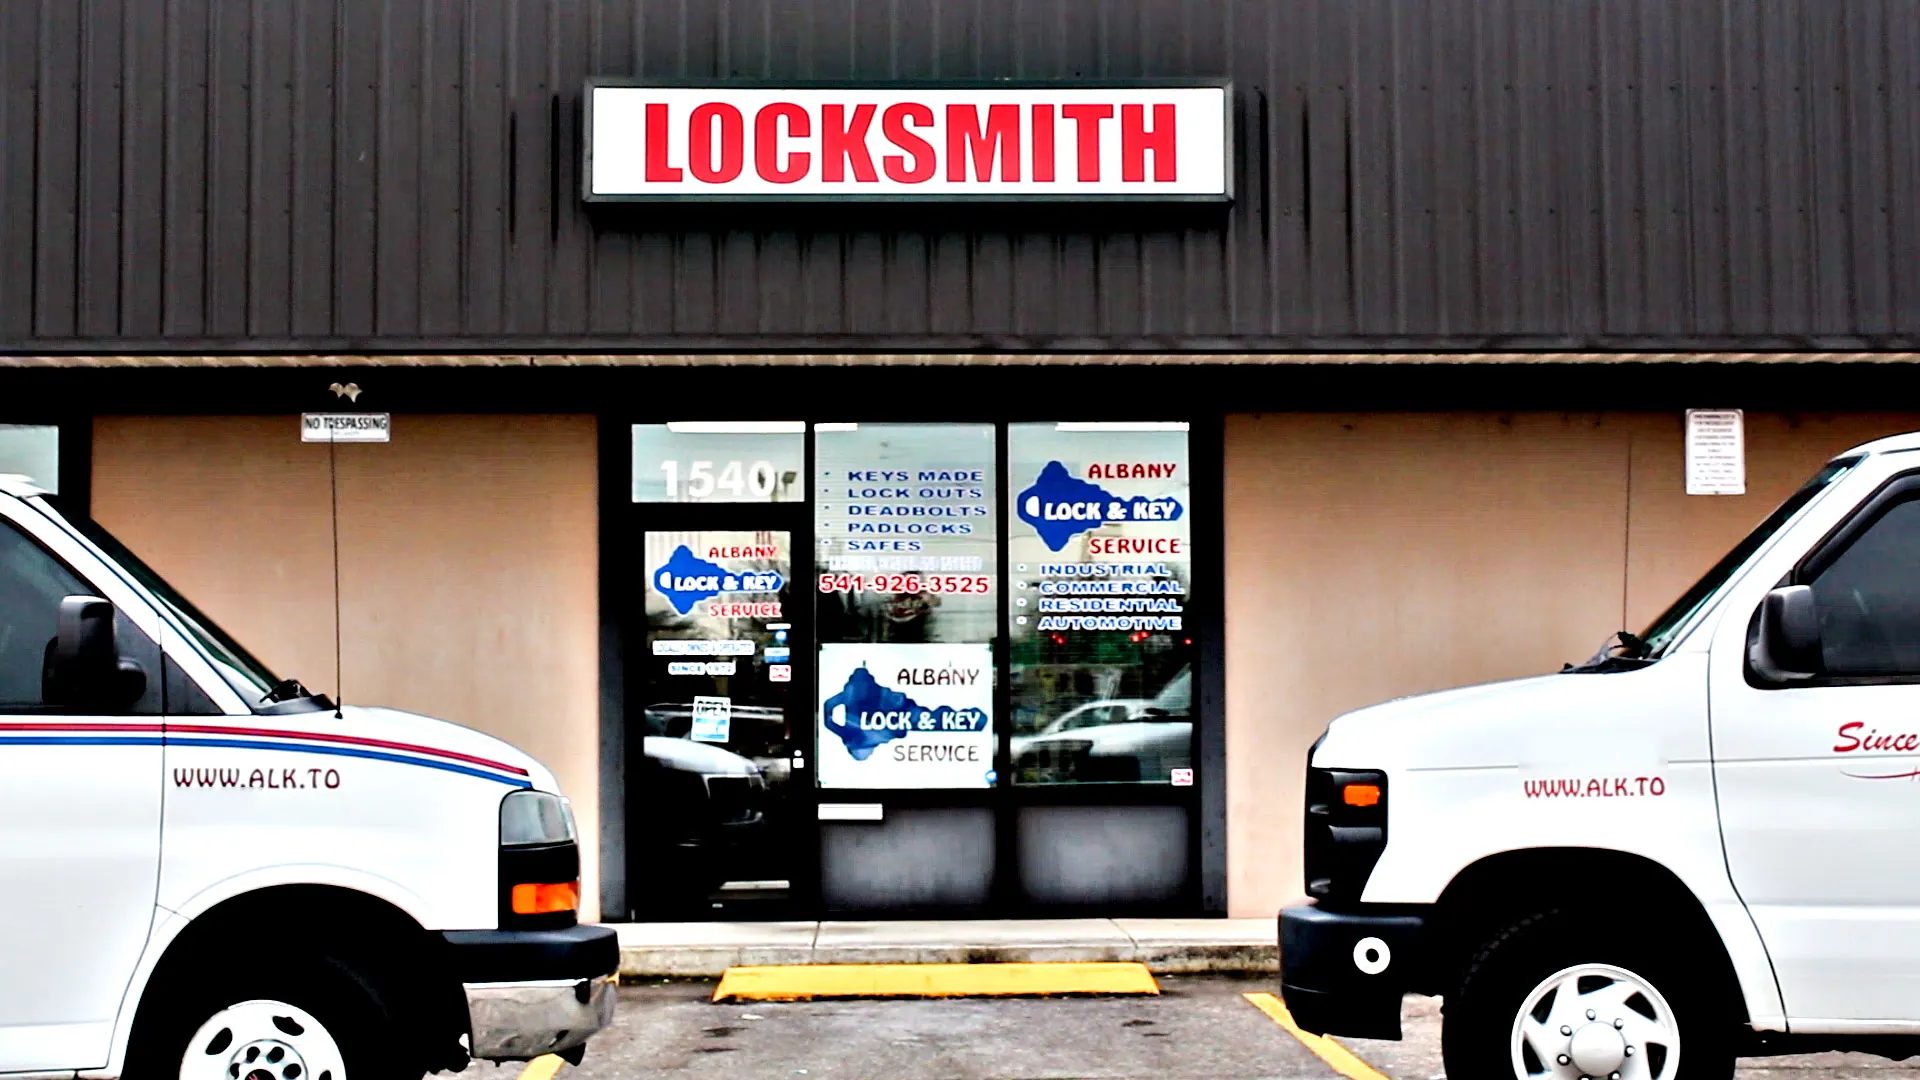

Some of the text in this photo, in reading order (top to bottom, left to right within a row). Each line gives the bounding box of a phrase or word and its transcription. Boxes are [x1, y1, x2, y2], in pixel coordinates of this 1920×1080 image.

[644, 102, 1177, 183] LOCKSMITH
[305, 417, 388, 430] NO TRESPASSING
[660, 460, 777, 498] 1540
[847, 471, 984, 482] KEYS MADE
[1088, 463, 1177, 479] ALBANY
[847, 488, 983, 499] LOCK OUTS
[847, 505, 988, 516] DEADBOLTS
[1044, 501, 1176, 520] LOCK & KEY
[847, 523, 973, 534] PADLOCKS
[708, 546, 778, 558] ALBANY
[847, 541, 922, 551] SAFES
[1090, 538, 1182, 554] SERVICE
[1040, 564, 1171, 575] INDUSTRIAL
[674, 575, 778, 591] LOCK & KEY
[818, 574, 990, 594] 541-926-3525
[1040, 582, 1184, 594] COMMERCIAL
[709, 602, 783, 617] SERVICE
[1040, 600, 1182, 611] RESIDENTIAL
[1039, 617, 1182, 629] AUTOMOTIVE
[897, 668, 980, 685] ALBANY
[860, 711, 981, 730] LOCK & KEY
[1833, 721, 1920, 753] Since
[893, 745, 980, 762] SERVICE
[173, 768, 341, 789] WWW.ALK.TO
[1523, 776, 1666, 799] WWW.ALK.TO
